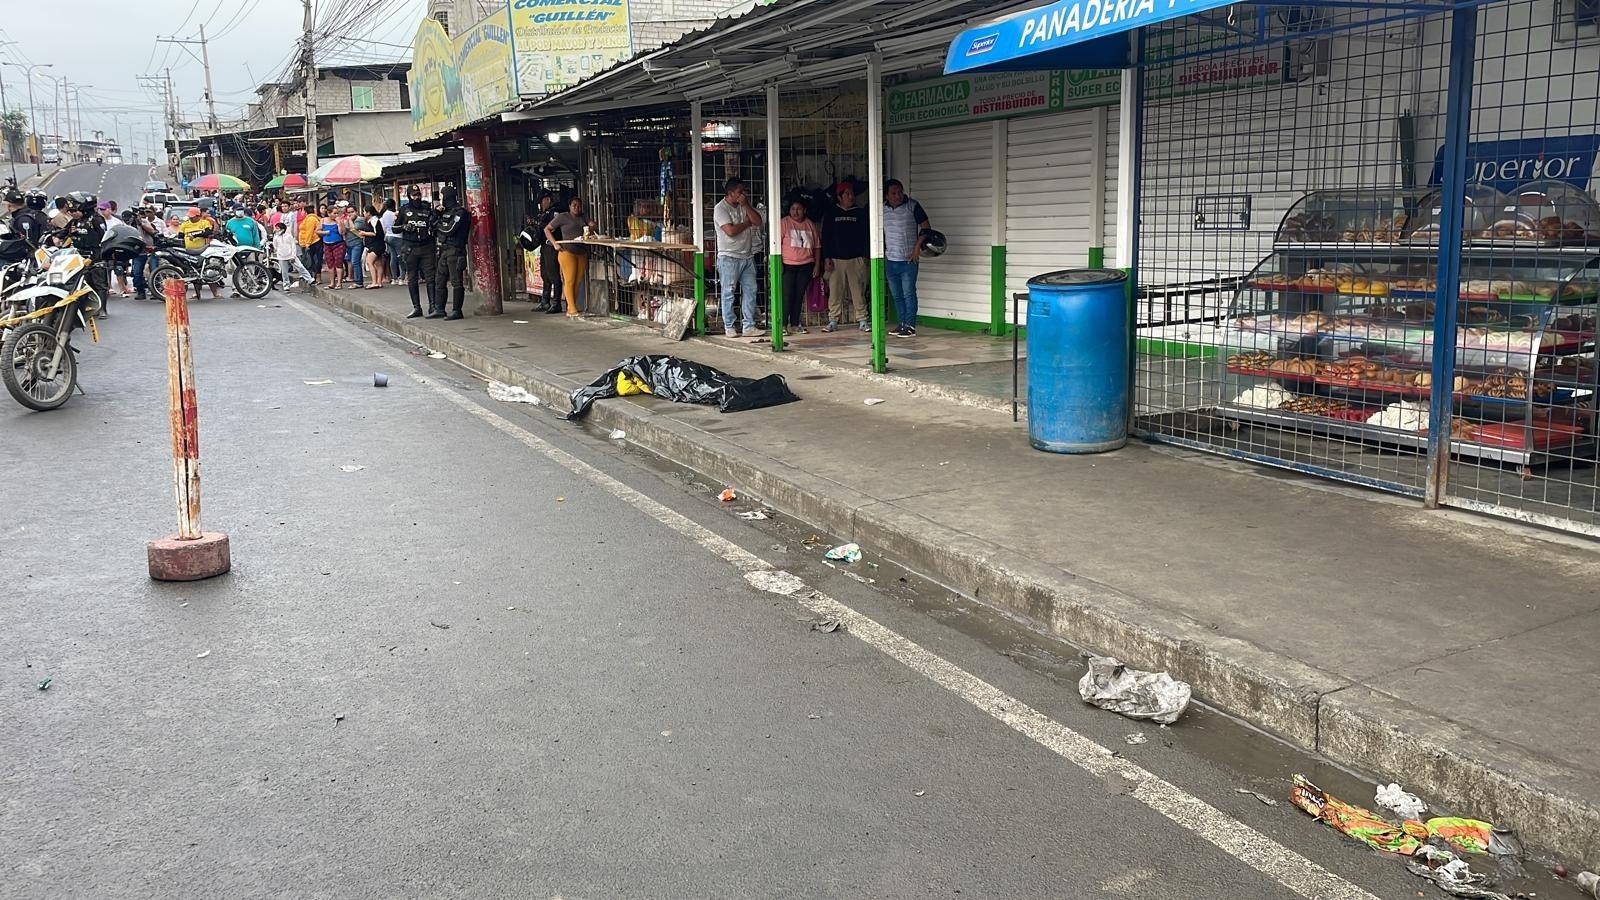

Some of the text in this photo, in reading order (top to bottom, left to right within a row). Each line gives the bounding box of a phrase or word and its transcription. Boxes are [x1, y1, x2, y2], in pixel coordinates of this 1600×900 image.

[552, 37, 586, 51] MAYOR
[597, 35, 629, 50] MENOR
[904, 82, 965, 108] FARMACIA
[1067, 83, 1100, 98] SUPER
[889, 103, 970, 124] SUPER ECONOMICA
[973, 96, 1045, 115] DISTRIBUIDOR
[1464, 153, 1581, 185] uperior
